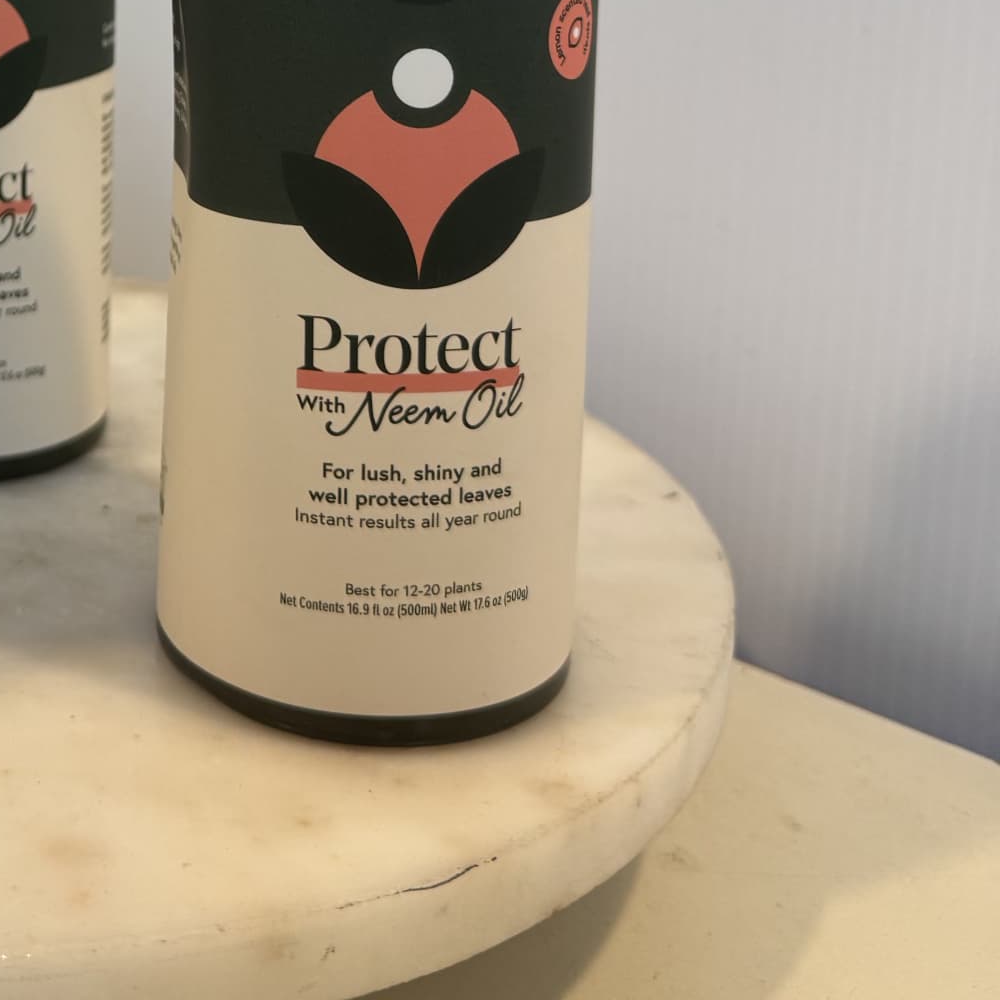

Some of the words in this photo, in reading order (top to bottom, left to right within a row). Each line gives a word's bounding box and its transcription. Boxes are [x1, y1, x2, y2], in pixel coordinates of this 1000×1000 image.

[297, 313, 522, 375] Protect
[297, 393, 345, 414] With
[325, 386, 456, 436] Neem
[461, 372, 525, 430] Oil
[322, 462, 354, 480] For
[361, 463, 406, 484] lush,
[413, 464, 465, 483] shiny
[470, 457, 502, 478] and
[308, 488, 348, 505] well
[355, 487, 452, 510] protected
[459, 485, 512, 504] leaves
[295, 506, 354, 528] Instant
[359, 512, 415, 529] results
[421, 512, 440, 528] all
[445, 514, 479, 531] year
[483, 501, 522, 523] round
[280, 592, 297, 608] Net
[299, 596, 344, 614] Contents
[347, 602, 370, 616] 16.9
[372, 603, 380, 616] fl
[383, 606, 395, 617] oz
[397, 602, 437, 618] (500ml)
[440, 601, 457, 615] Net
[459, 600, 471, 613] Wt
[474, 597, 490, 610] 17.6
[492, 596, 502, 607] oz
[503, 586, 529, 608] (500g)
[345, 583, 375, 597] Best
[380, 583, 399, 597] for
[403, 583, 440, 598] 12-20
[444, 580, 482, 598] plants
